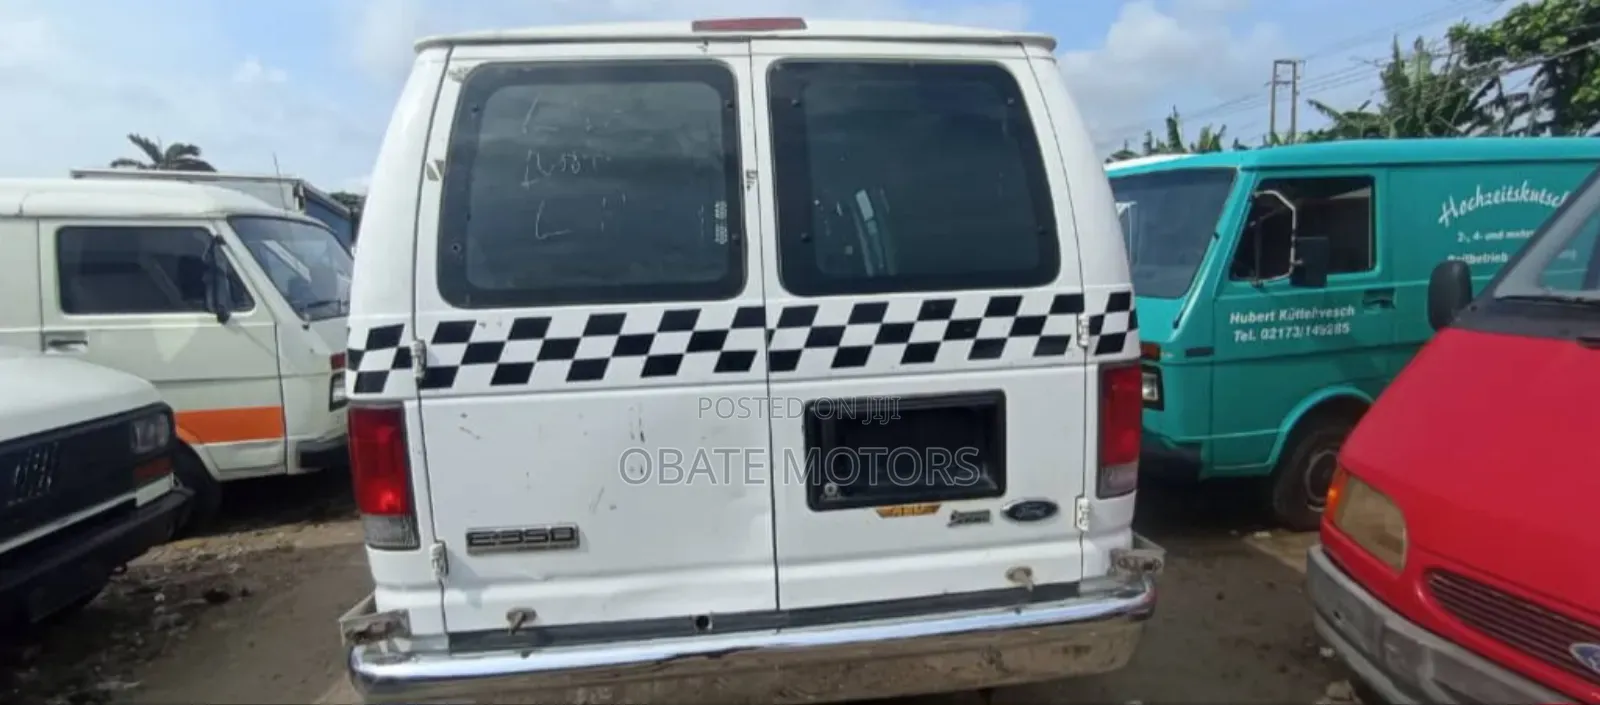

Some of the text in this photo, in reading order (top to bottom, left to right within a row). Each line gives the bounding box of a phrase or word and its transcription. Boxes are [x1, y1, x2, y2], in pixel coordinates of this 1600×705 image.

[1485, 230, 1504, 241] und
[1229, 311, 1275, 324] Hubert
[1233, 328, 1257, 343] Tel.
